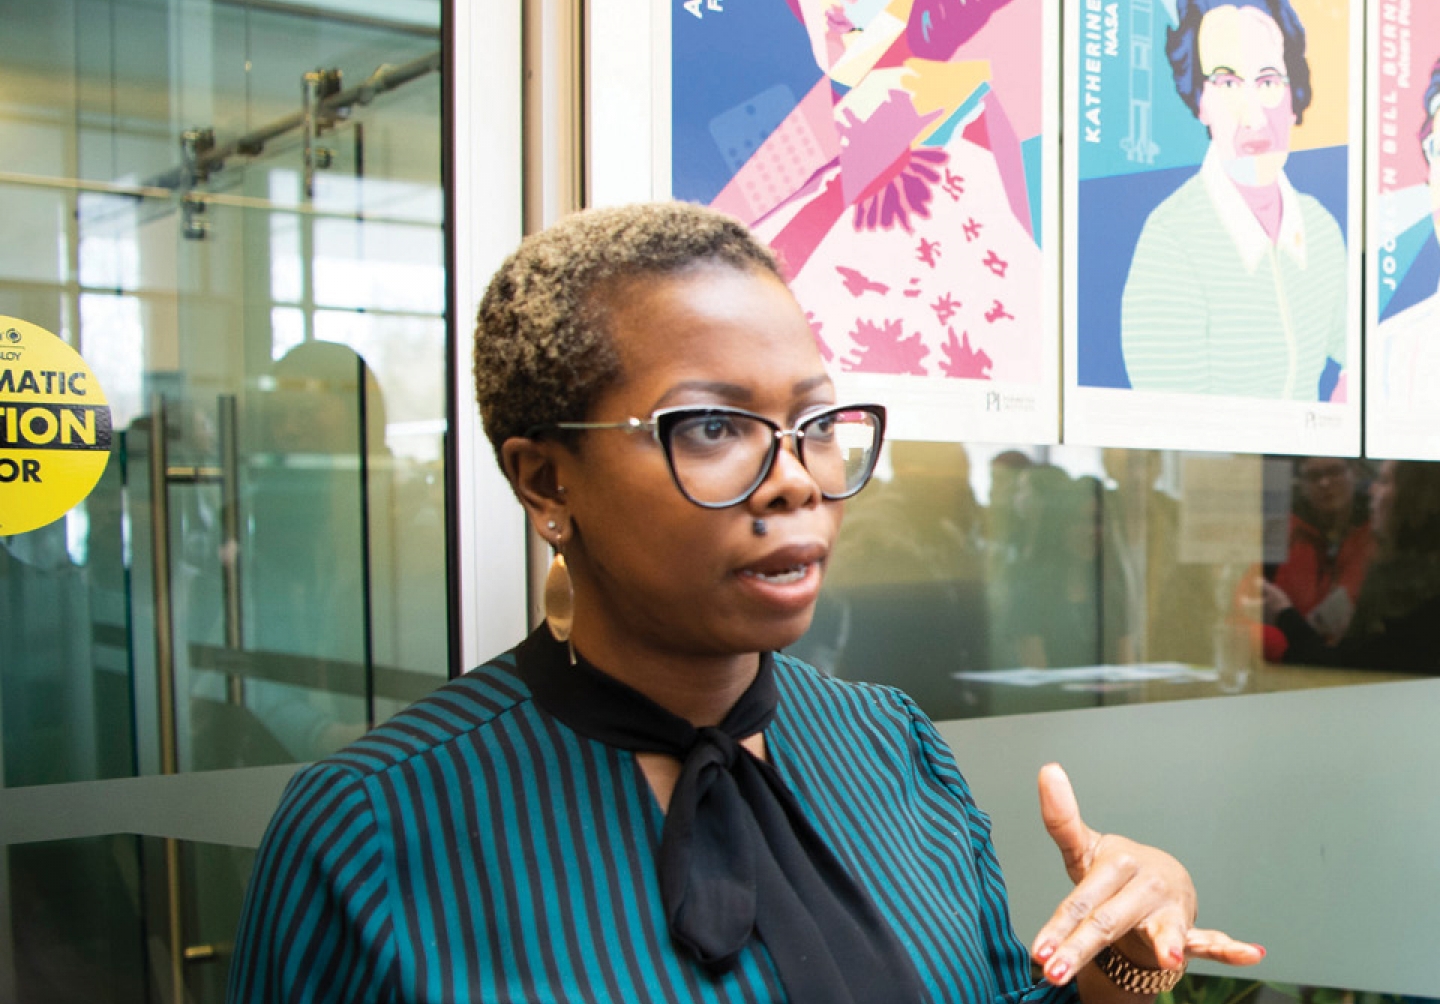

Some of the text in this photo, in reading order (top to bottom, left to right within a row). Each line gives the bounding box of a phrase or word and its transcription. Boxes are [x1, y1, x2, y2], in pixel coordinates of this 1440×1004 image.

[1103, 2, 1118, 56] NASA
[1085, 0, 1101, 143] KATHERINE
[1382, 0, 1398, 291] JOCYN BELL BURN
[0, 407, 96, 445] ION
[0, 458, 42, 483] OR
